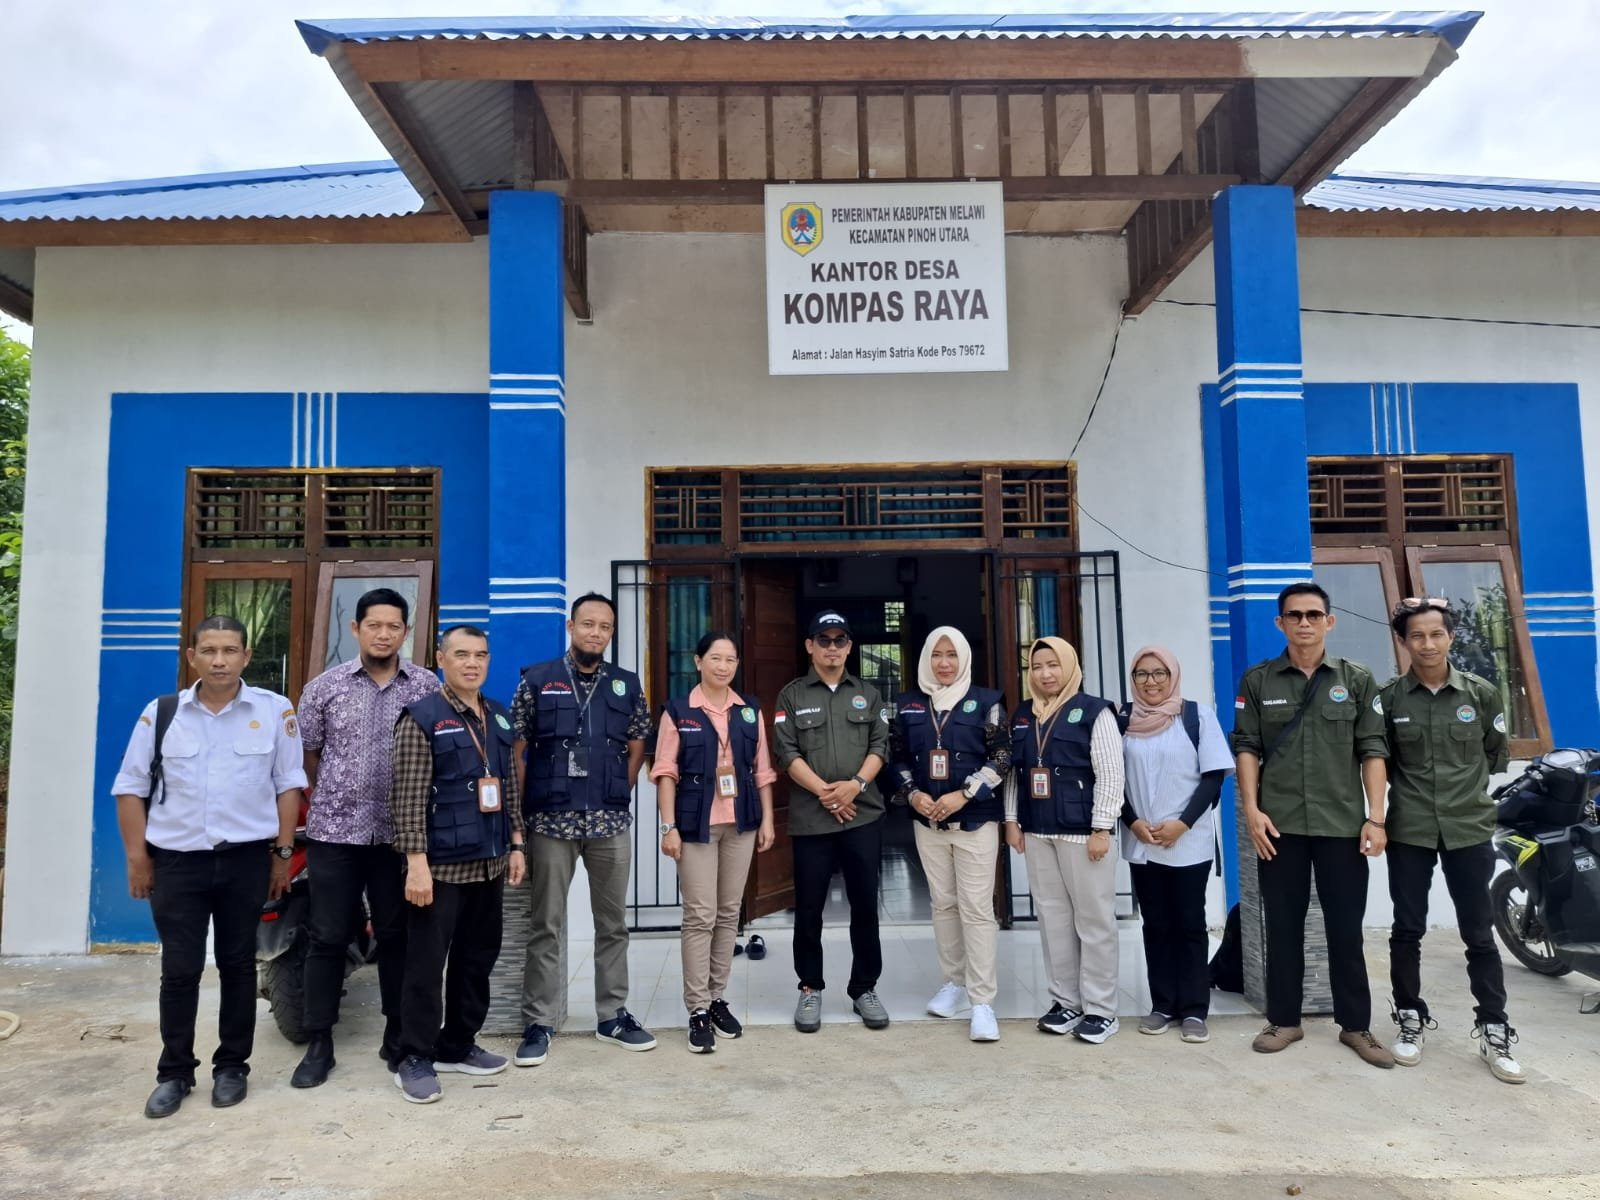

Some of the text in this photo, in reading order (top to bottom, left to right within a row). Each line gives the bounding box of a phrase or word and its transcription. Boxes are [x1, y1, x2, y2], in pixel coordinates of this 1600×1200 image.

[832, 205, 985, 223] PEMERINTAH KABUPATEN MELAWI
[849, 227, 969, 244] KECAMATAN PINOH UTARA
[811, 259, 960, 283] KANTOR DESA
[784, 289, 989, 325] KOMPAS RAYA
[792, 349, 822, 360] Alamat
[830, 348, 853, 359] Jalan
[855, 347, 887, 361] Hasyim
[889, 346, 915, 358] Satria
[917, 346, 939, 357] Kode
[941, 345, 957, 356] Pos
[959, 344, 985, 356] 79672
